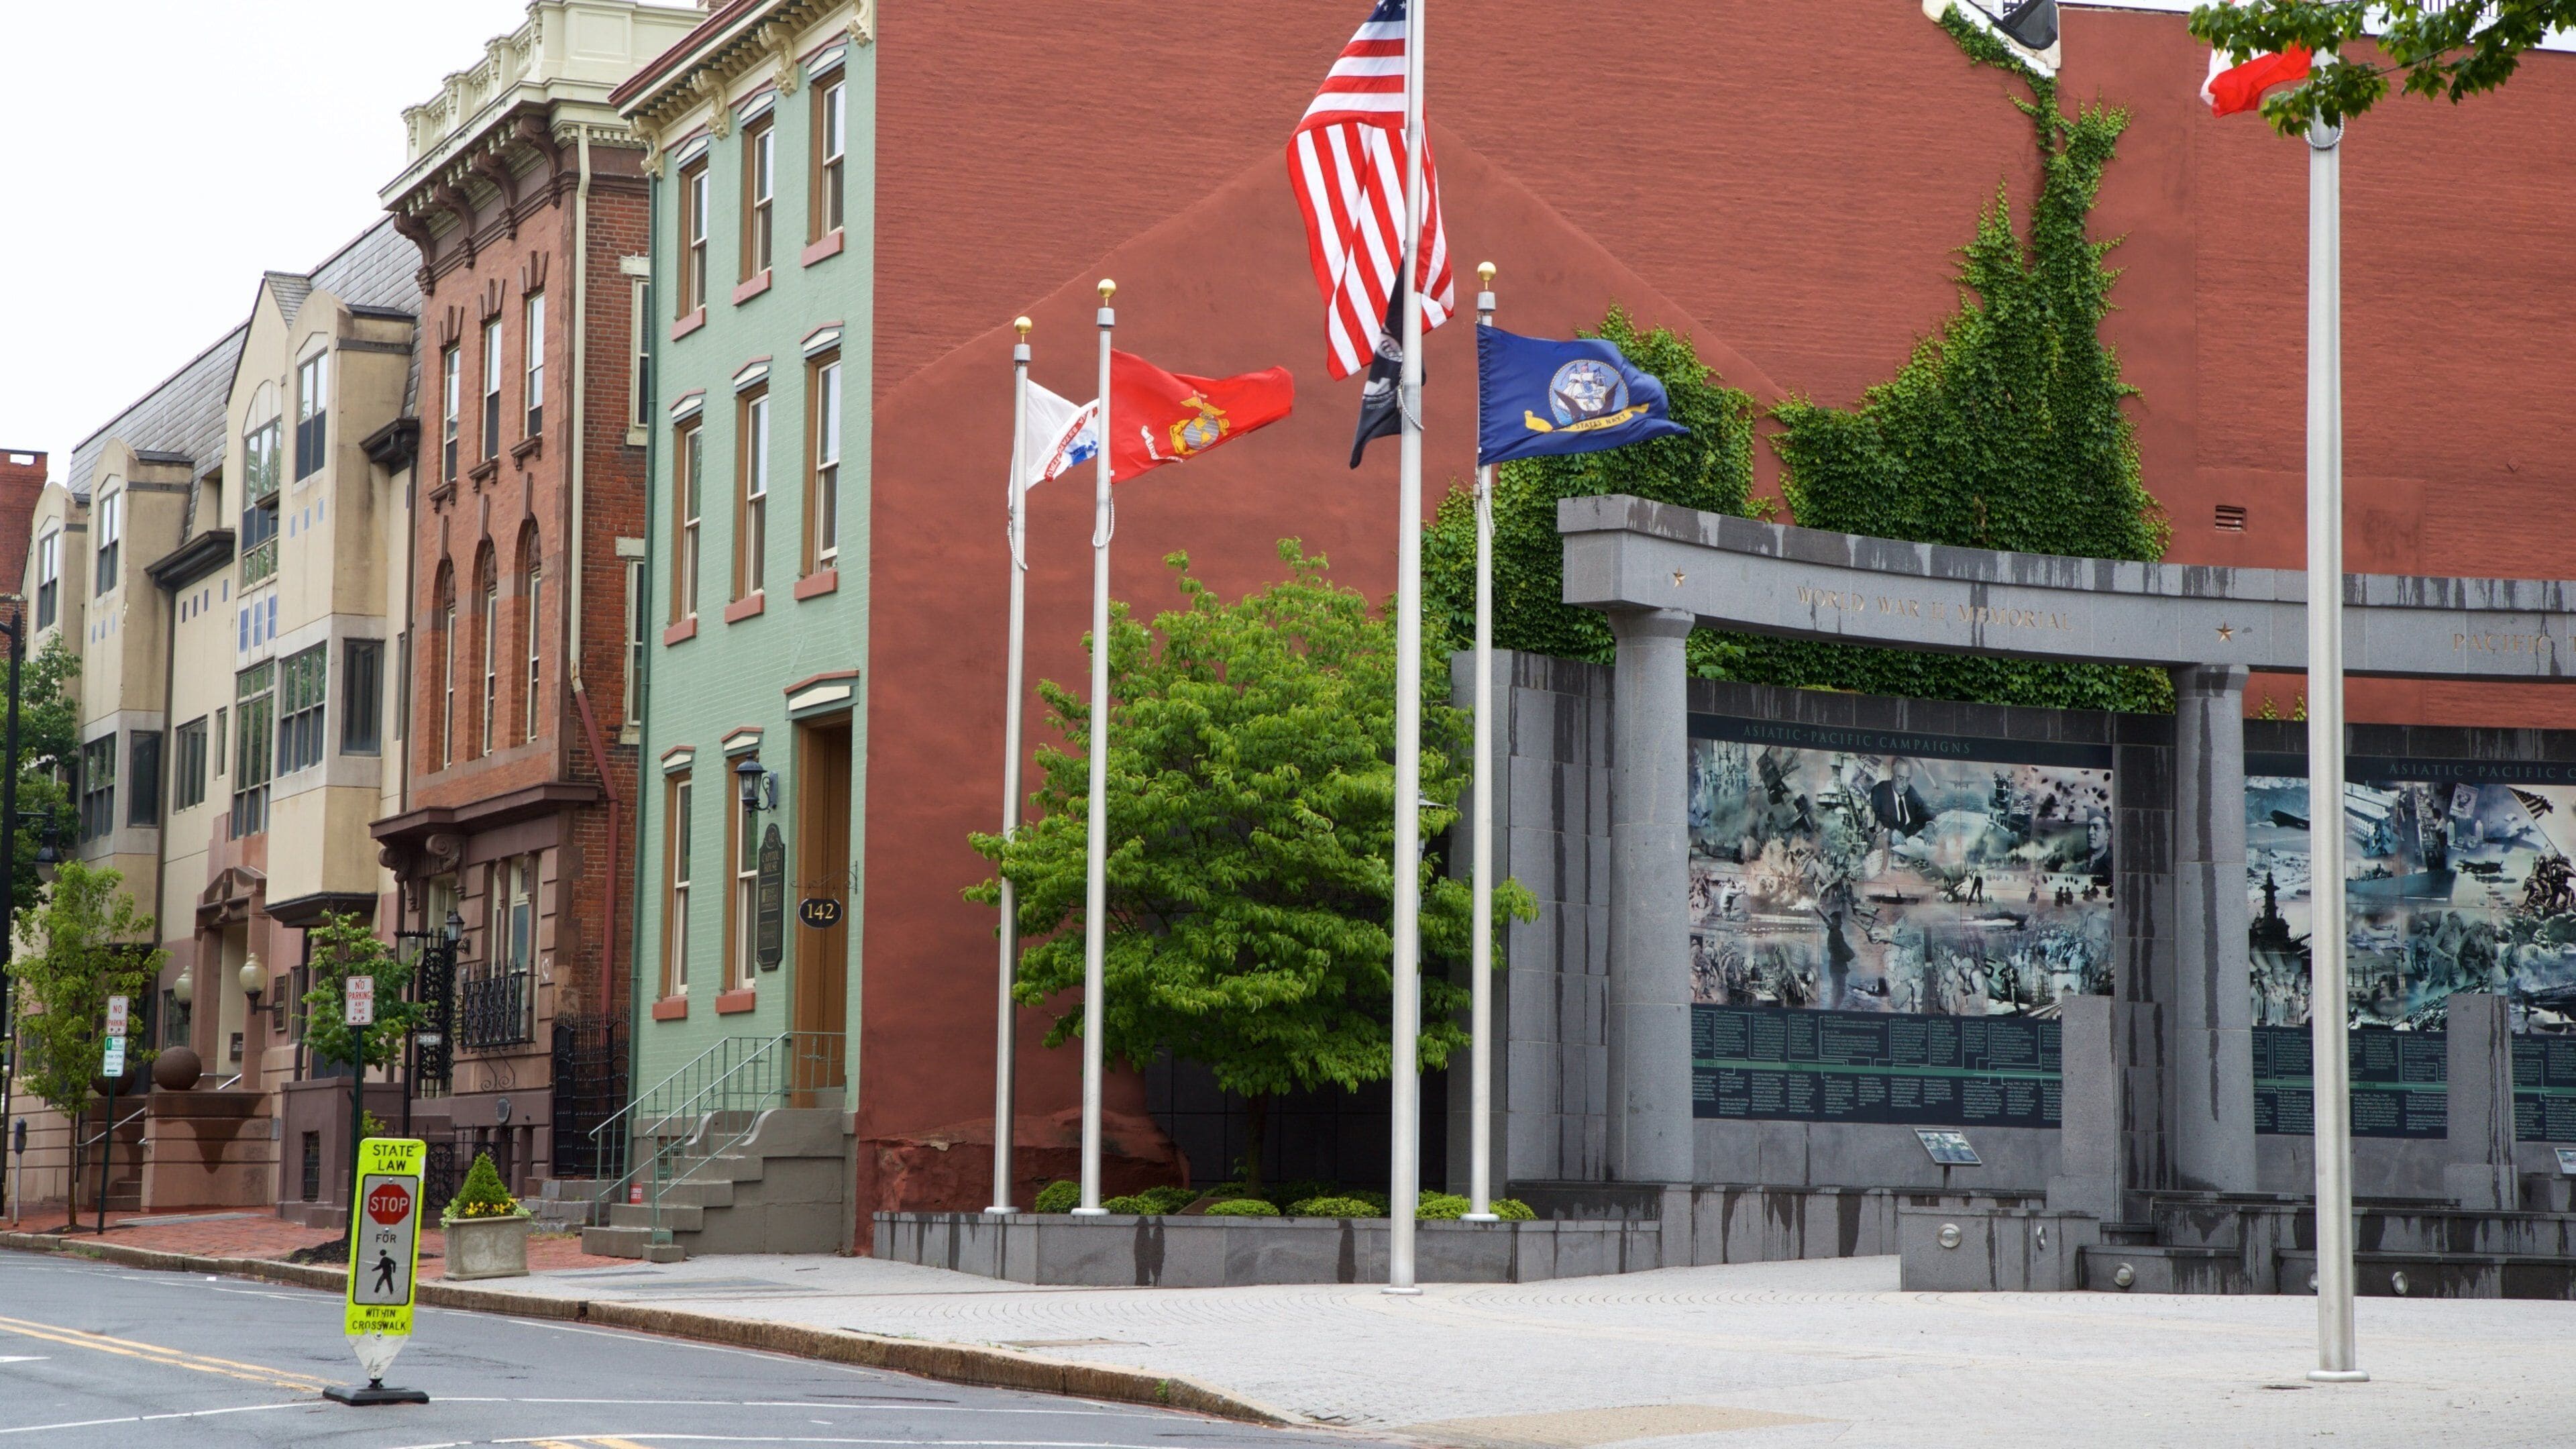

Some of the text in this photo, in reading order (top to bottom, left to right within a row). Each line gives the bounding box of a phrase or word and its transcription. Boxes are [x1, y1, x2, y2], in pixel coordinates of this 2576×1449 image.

[1576, 421, 1602, 429] STATES
[1605, 413, 1626, 425] NAVY
[1796, 586, 2074, 631] WORLD WAR II MEMORIAL
[2453, 633, 2552, 654] PACIFIC
[1743, 725, 1970, 754] ASIATIC-PACIFIC CAMPAIGNS
[2388, 763, 2557, 778] ASIATIC-PACIFIC
[761, 850, 780, 863] CAPITOL
[763, 863, 778, 873] HOUSE
[807, 903, 835, 920] 142
[355, 981, 365, 989] NO
[348, 991, 371, 1000] PARKING
[113, 1005, 122, 1014] NO
[372, 1144, 414, 1157] STATE
[378, 1159, 407, 1171] LAW
[370, 1196, 409, 1213] STOP
[375, 1234, 397, 1244] FOR
[366, 1309, 396, 1318] WITHIN
[352, 1320, 407, 1331] CROSSWALK
